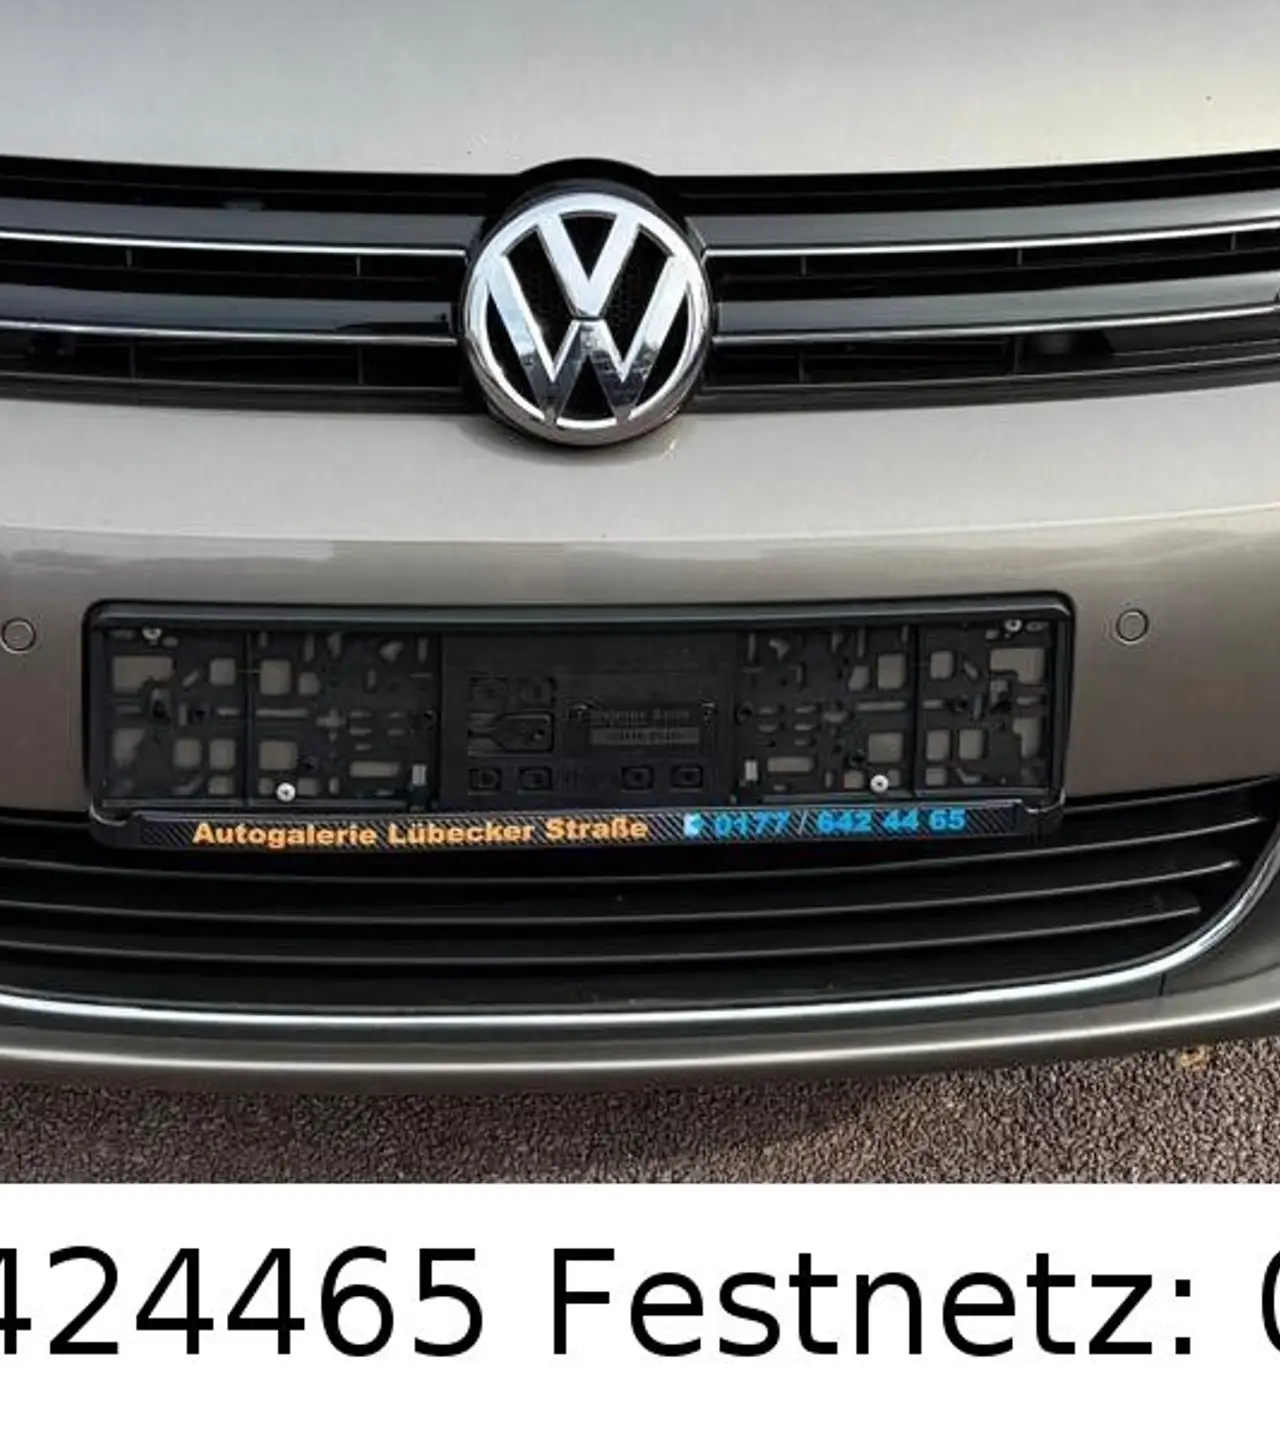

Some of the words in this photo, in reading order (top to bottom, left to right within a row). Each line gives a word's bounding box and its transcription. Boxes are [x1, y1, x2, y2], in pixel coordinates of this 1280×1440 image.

[191, 821, 378, 850] Autogalerie
[387, 819, 536, 846] Lübecker
[544, 816, 650, 841] Straße
[714, 811, 791, 837] 0177
[816, 810, 871, 835] 642
[881, 809, 920, 833] 44
[928, 807, 967, 831] 65
